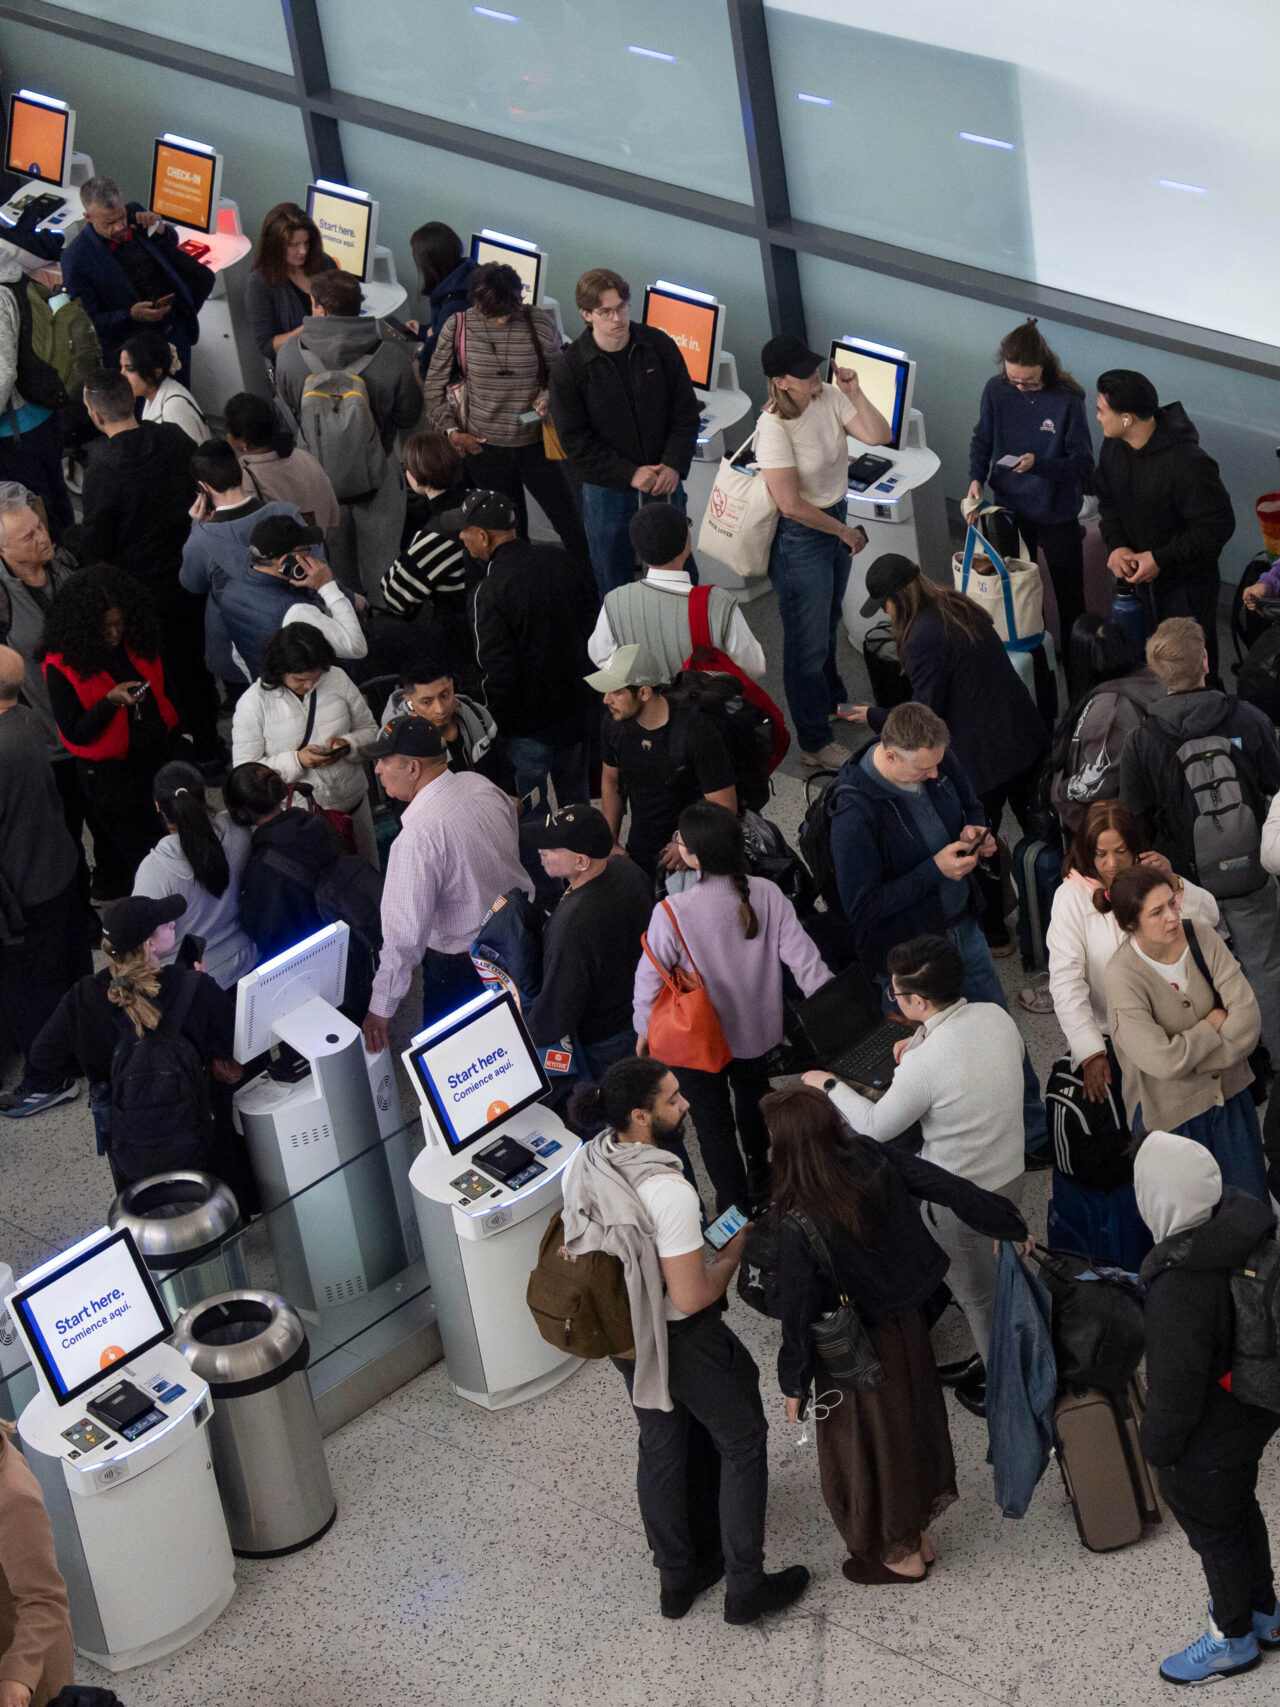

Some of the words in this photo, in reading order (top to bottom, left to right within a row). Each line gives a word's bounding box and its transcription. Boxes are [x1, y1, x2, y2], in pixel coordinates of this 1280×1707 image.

[167, 166, 201, 184] CHECK-IN
[320, 218, 337, 232] Start
[338, 224, 356, 238] here.
[689, 336, 700, 352] in.
[492, 966, 510, 984] CENTER
[448, 1062, 479, 1088] Start
[478, 1048, 508, 1070] here.
[546, 1060, 568, 1070] KEYSTONE
[453, 1073, 494, 1102] Comience
[494, 1058, 514, 1076] aquí.
[55, 1306, 92, 1334] Start
[90, 1288, 124, 1314] here.
[62, 1315, 108, 1349] Comience
[110, 1300, 132, 1320] aquí.
